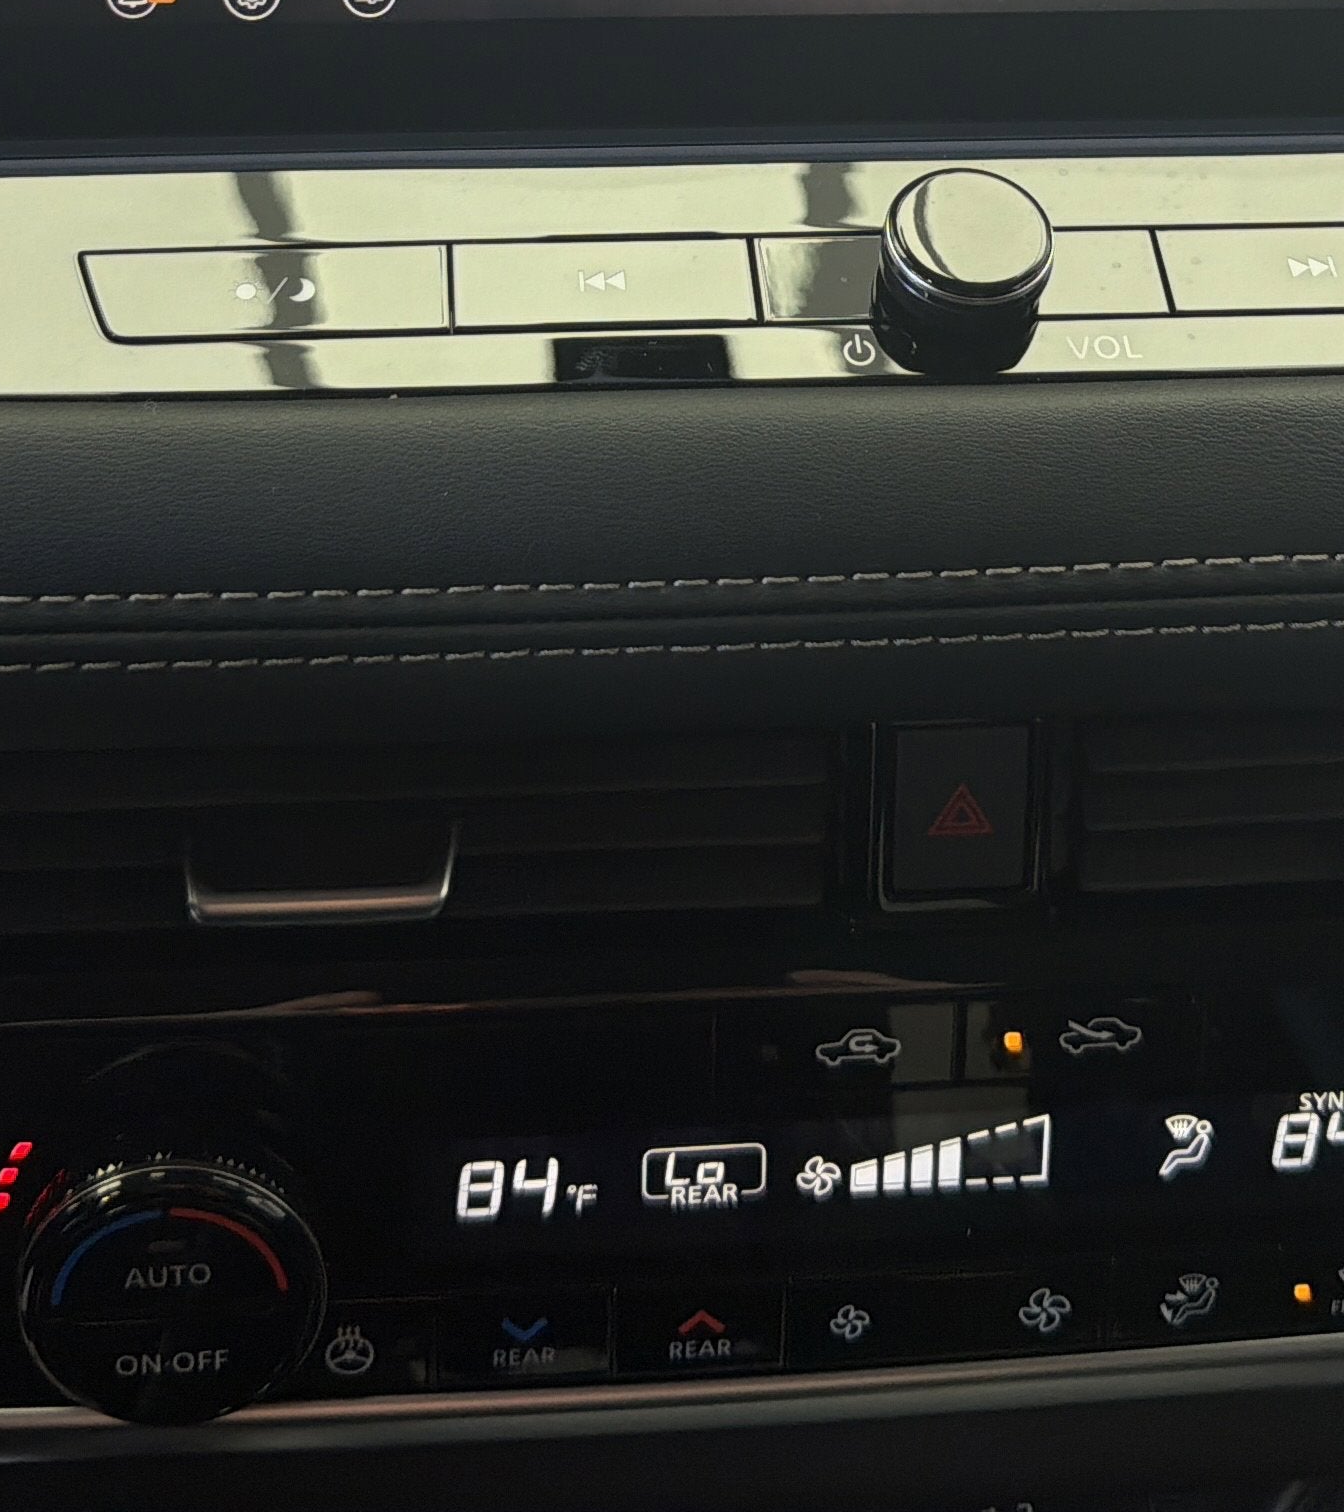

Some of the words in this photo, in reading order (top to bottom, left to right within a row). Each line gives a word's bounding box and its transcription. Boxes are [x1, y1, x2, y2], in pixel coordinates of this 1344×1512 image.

[1066, 334, 1143, 363] VOL
[669, 1183, 739, 1206] REAR
[124, 1262, 212, 1290] AUTO
[493, 1346, 556, 1368] REAR
[669, 1338, 732, 1361] REAR
